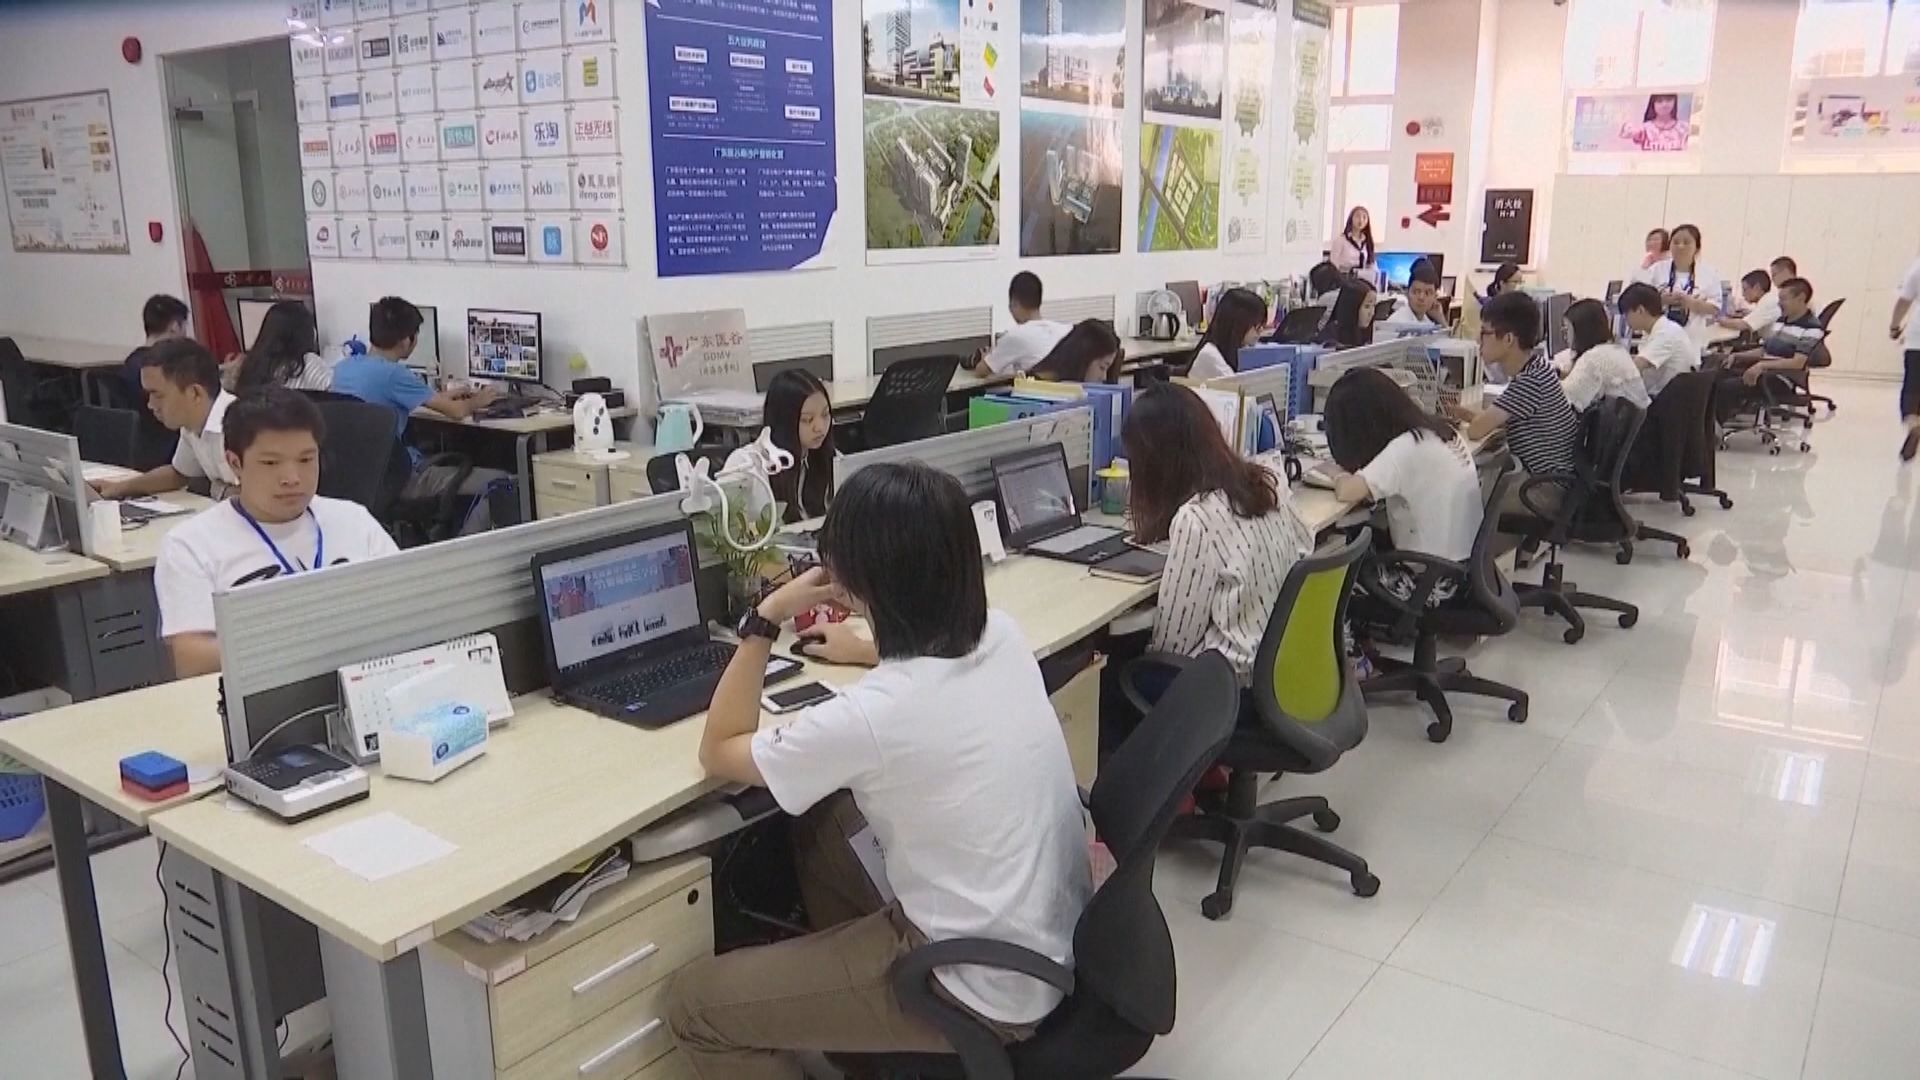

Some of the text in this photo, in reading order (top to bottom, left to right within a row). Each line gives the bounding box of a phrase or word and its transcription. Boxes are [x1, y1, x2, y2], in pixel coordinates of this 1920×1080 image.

[534, 121, 560, 141] 乐淘
[574, 120, 613, 136] 正益无线
[579, 191, 617, 201] ifeng.com
[685, 332, 743, 351] 广东医谷
